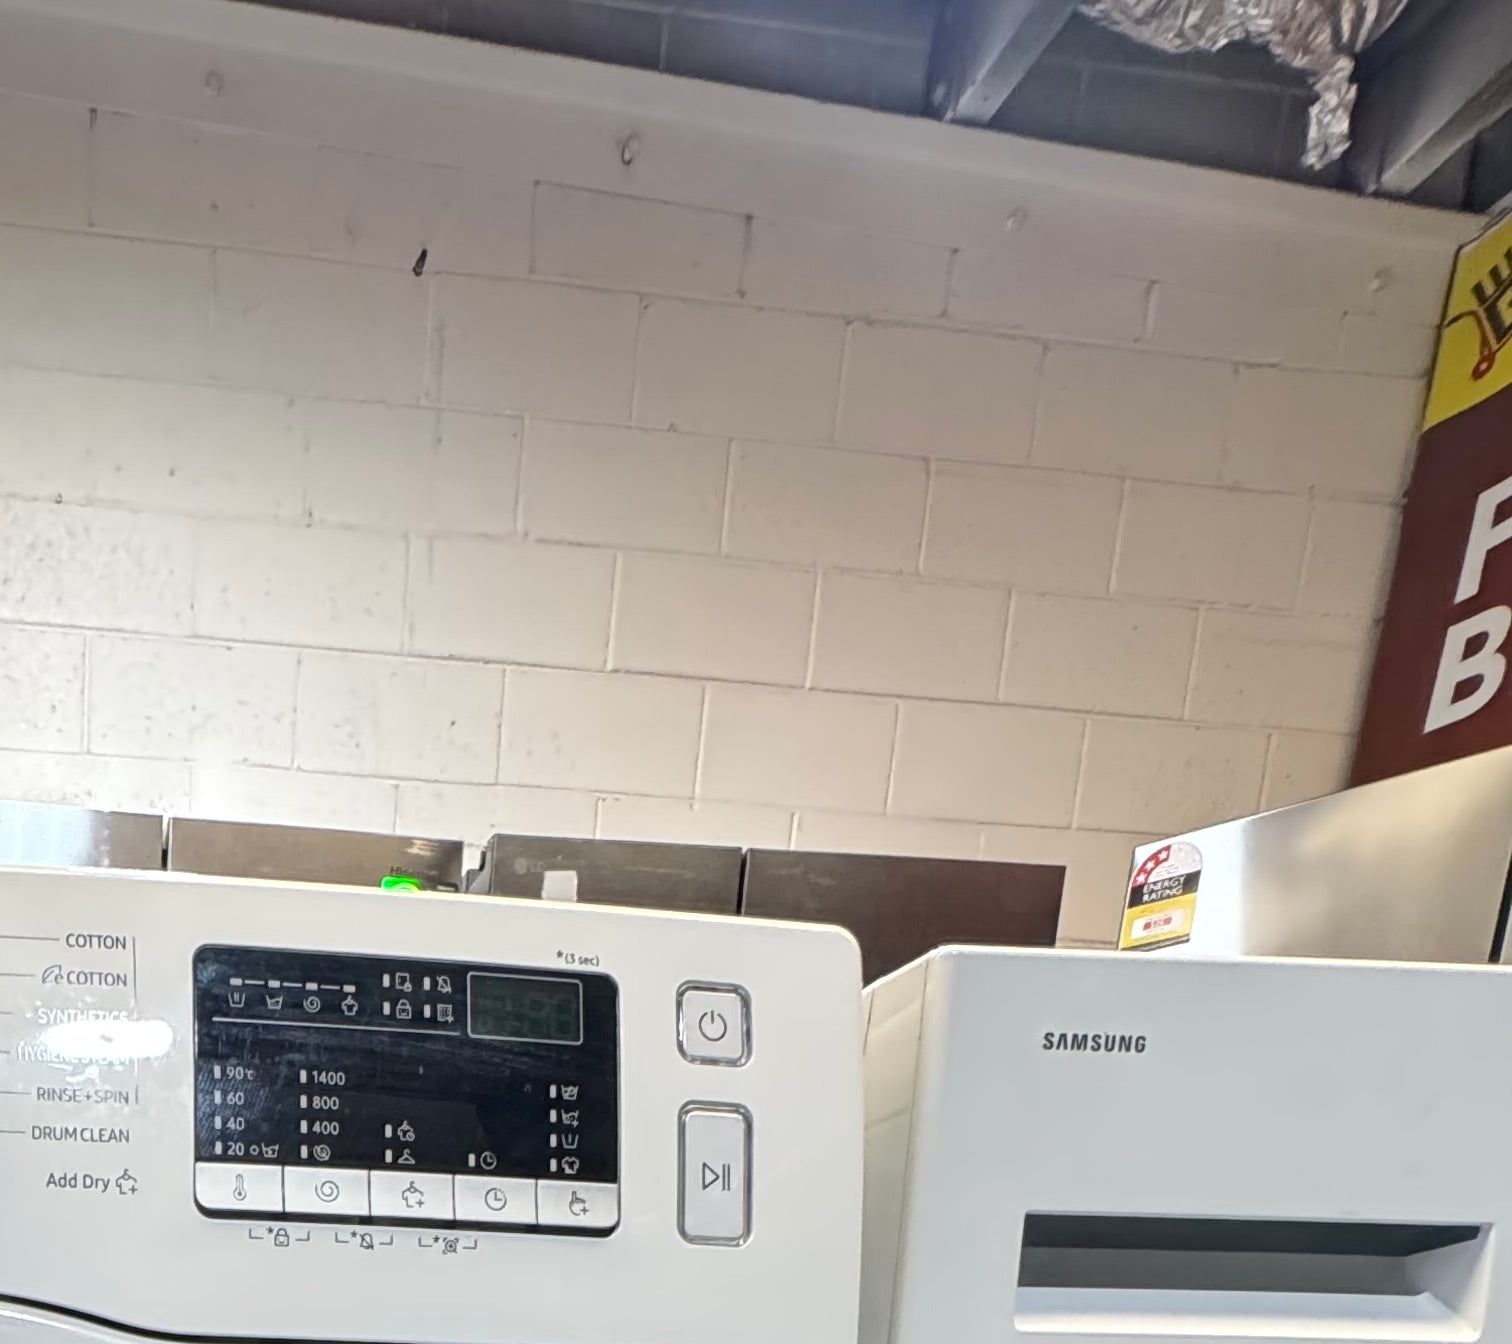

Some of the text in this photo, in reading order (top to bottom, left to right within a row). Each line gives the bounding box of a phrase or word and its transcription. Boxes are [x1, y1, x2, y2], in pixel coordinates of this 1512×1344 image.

[1423, 604, 1511, 735] B
[65, 932, 127, 950] COTTON
[578, 954, 600, 967] sec)
[66, 969, 128, 987] COTTON
[1042, 1031, 1147, 1054] SAMSUNG
[311, 1070, 346, 1086] 1400
[226, 1091, 245, 1106] 60
[312, 1095, 339, 1111] 800
[225, 1116, 246, 1131] 40
[312, 1120, 340, 1136] 400
[31, 1125, 130, 1144] DRUM CLEAN
[226, 1141, 245, 1156] 20
[45, 1171, 111, 1194] Add Dry
